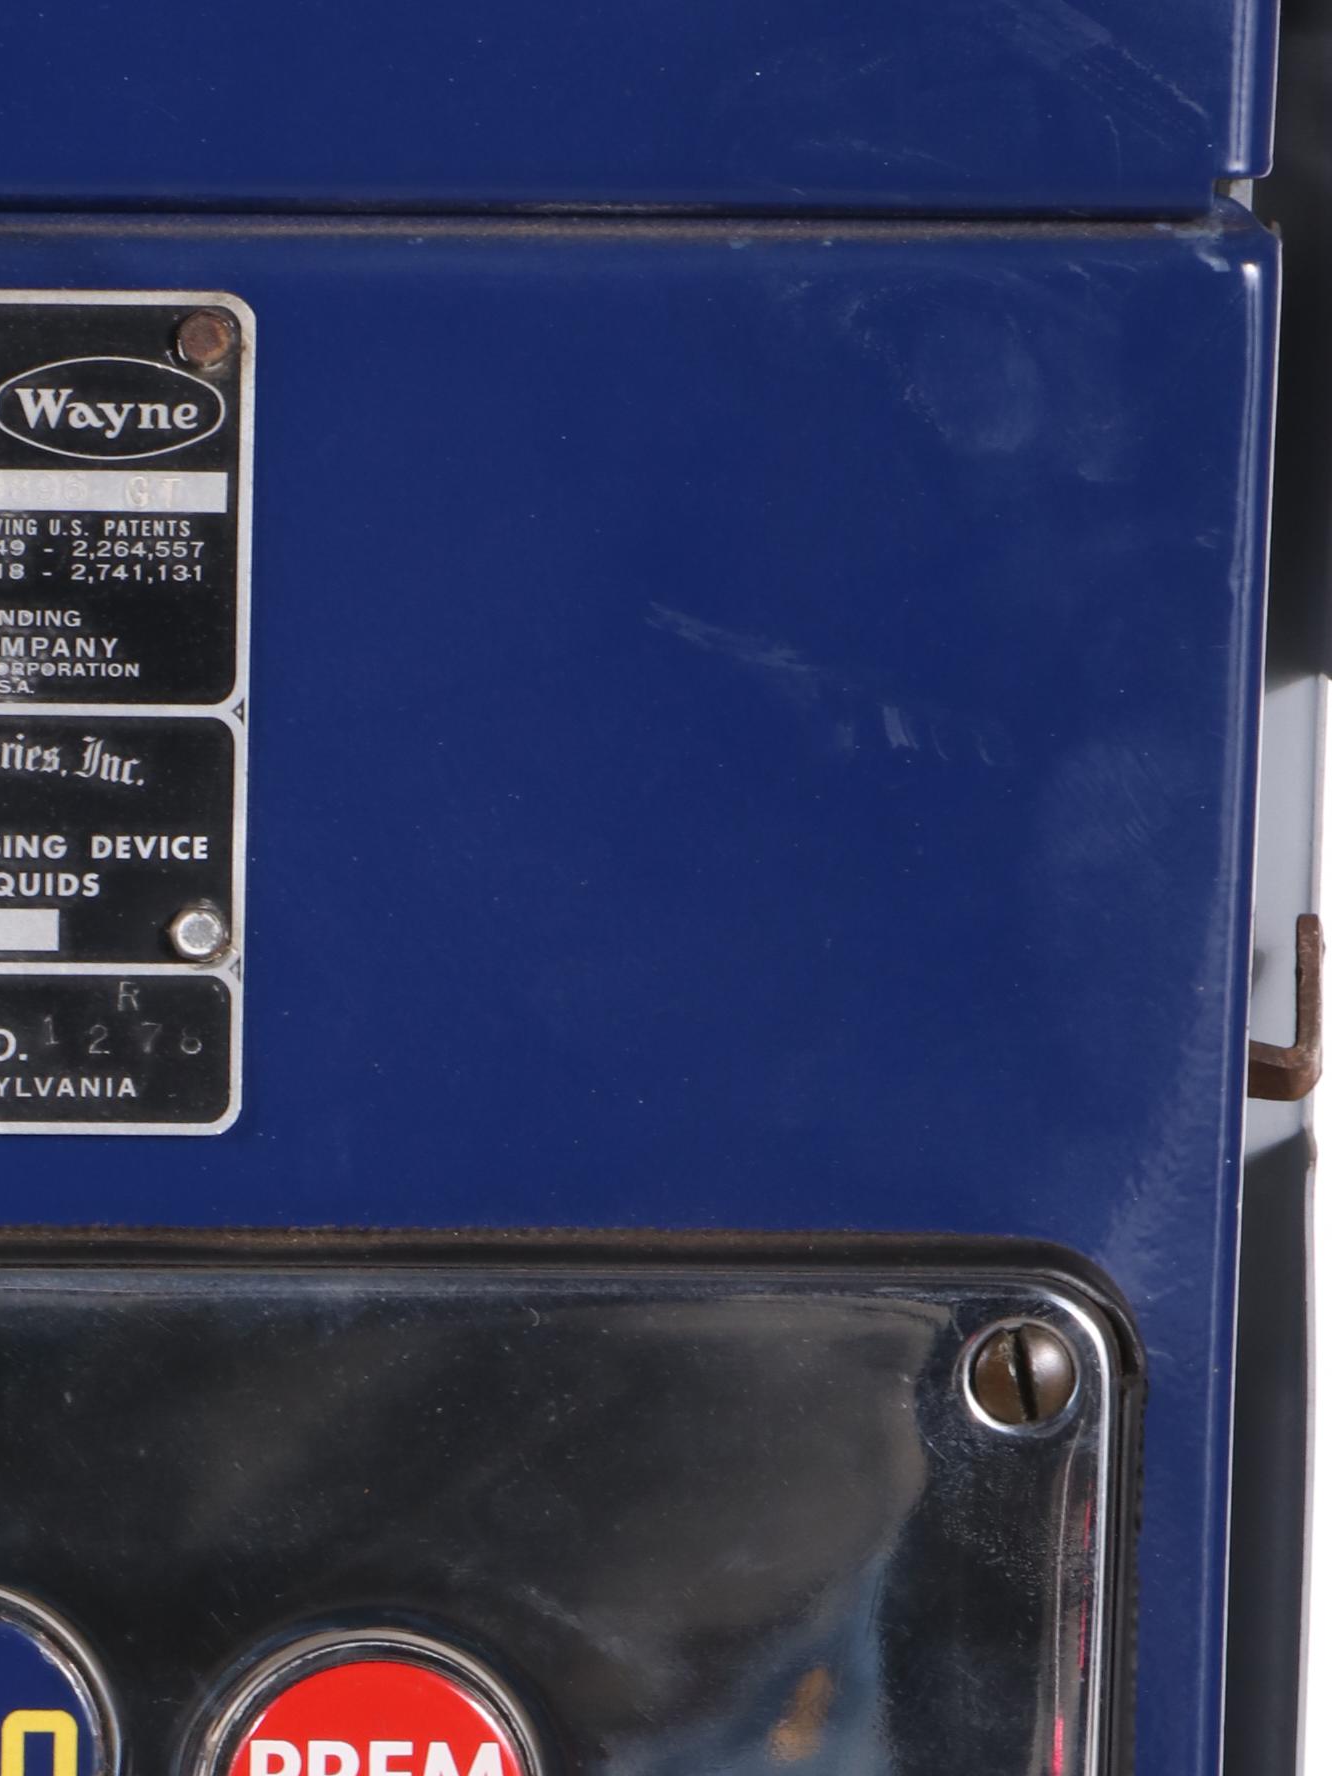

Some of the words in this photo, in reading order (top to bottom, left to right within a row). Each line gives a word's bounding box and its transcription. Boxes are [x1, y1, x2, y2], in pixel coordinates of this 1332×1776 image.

[15, 388, 199, 439] Wayne
[49, 519, 90, 537] U.S.
[104, 520, 191, 538] PATENTS
[72, 541, 205, 560] 2,264,557
[70, 564, 203, 584] 2,741,131
[74, 736, 146, 787] Inc.
[91, 836, 209, 860] DEVICE
